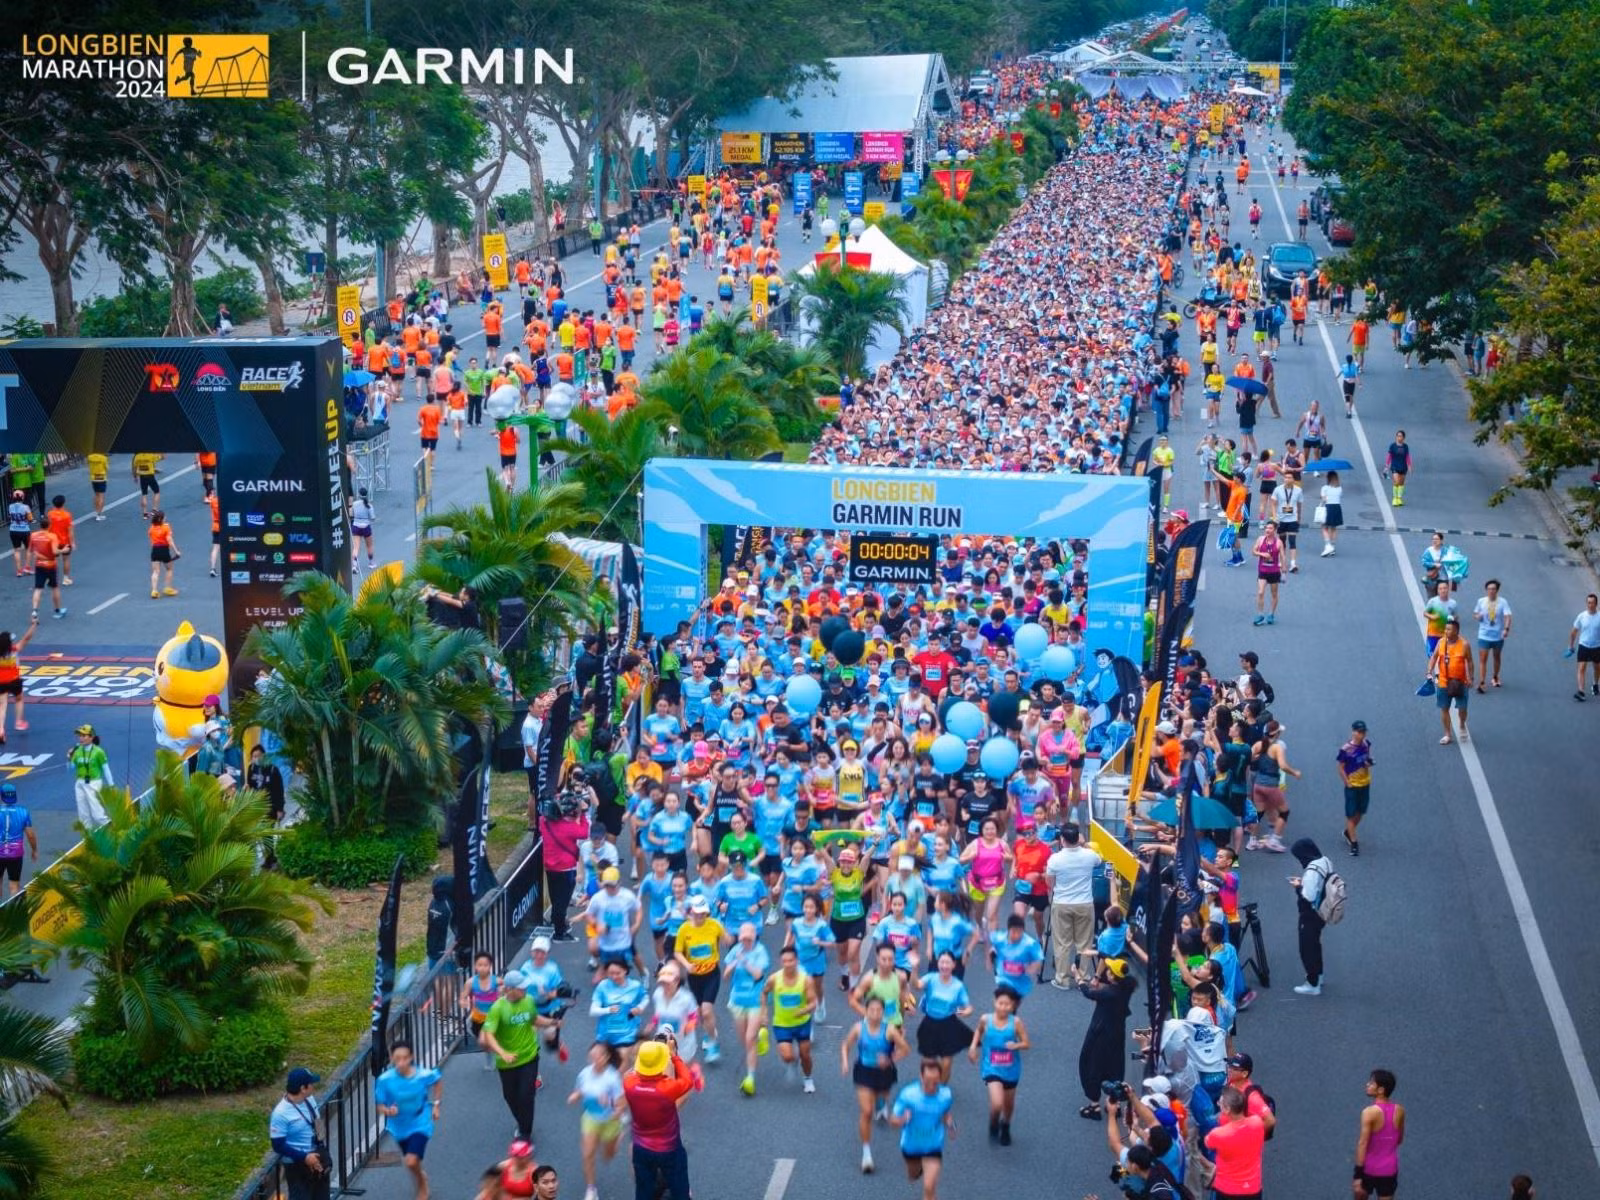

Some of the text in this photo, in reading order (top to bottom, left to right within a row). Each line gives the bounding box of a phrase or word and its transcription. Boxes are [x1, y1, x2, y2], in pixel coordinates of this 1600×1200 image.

[241, 367, 289, 380] RACE
[231, 480, 304, 493] GARMIN
[832, 479, 936, 503] LONGBIEN
[832, 503, 962, 528] GARMIN RUN
[859, 543, 930, 560] 00:00:04
[854, 565, 933, 580] GARMIN
[245, 607, 305, 617] LEVEL UP
